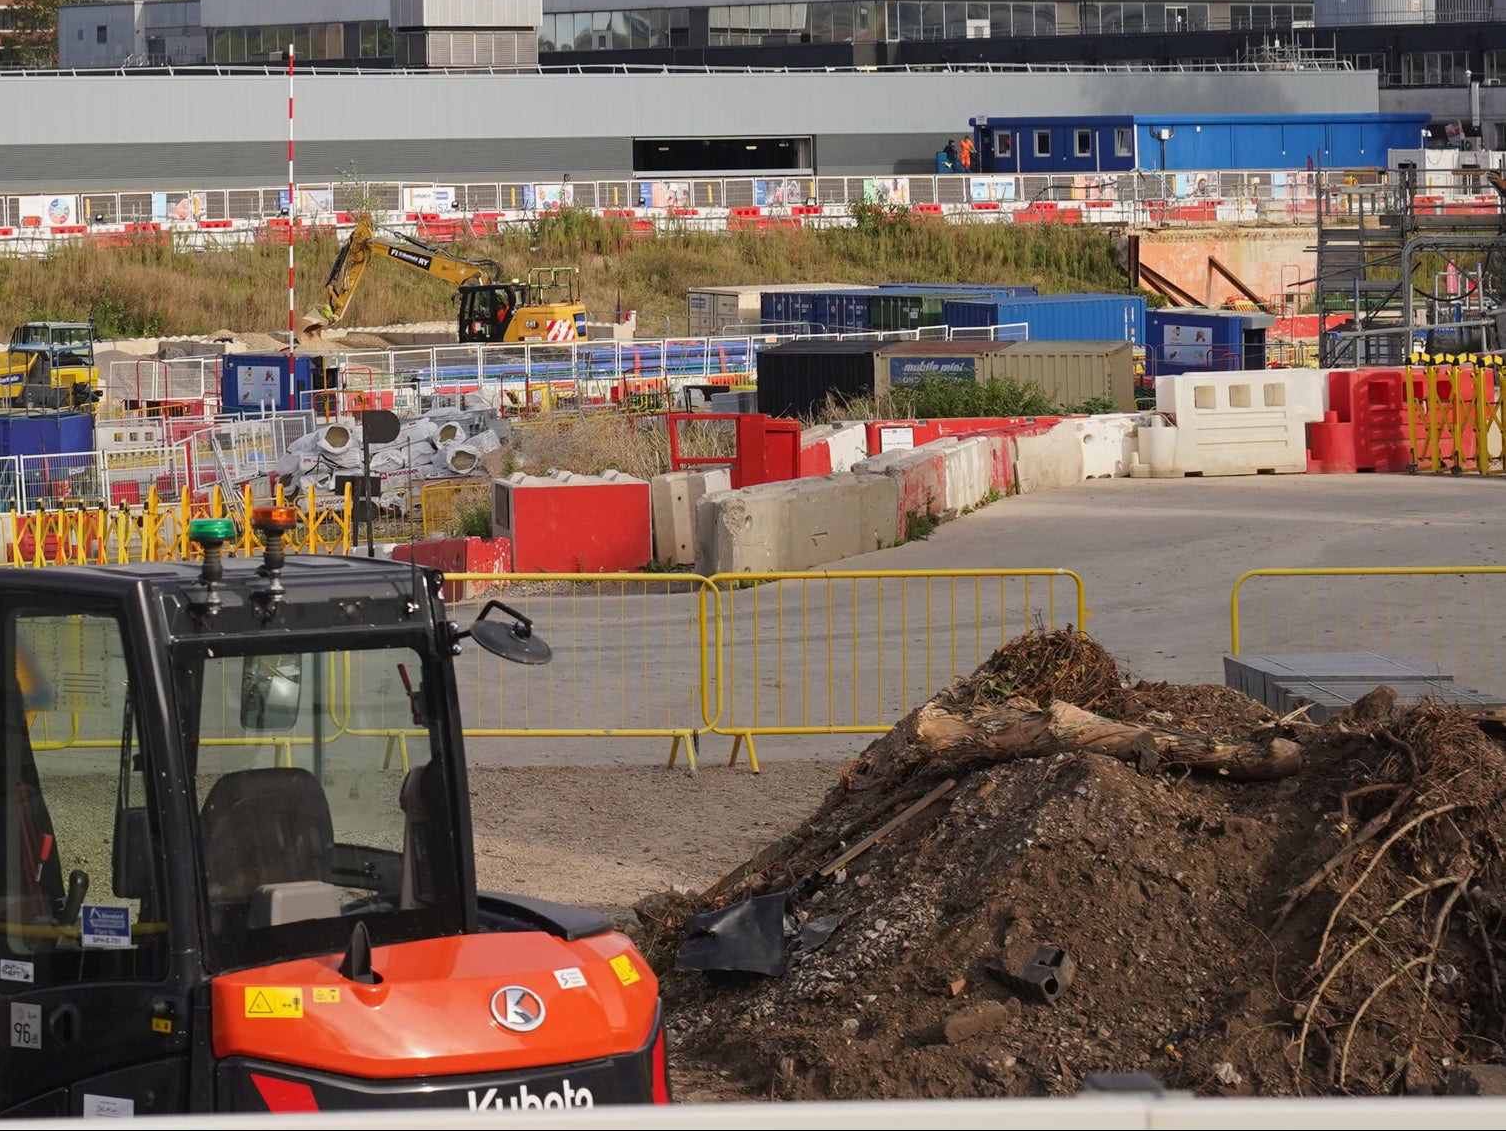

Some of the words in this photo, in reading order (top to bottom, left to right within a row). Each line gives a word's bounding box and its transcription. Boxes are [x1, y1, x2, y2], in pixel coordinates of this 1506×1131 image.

[903, 361, 939, 372] mobile
[13, 1022, 31, 1044] 96
[467, 1078, 594, 1111] Kubota
